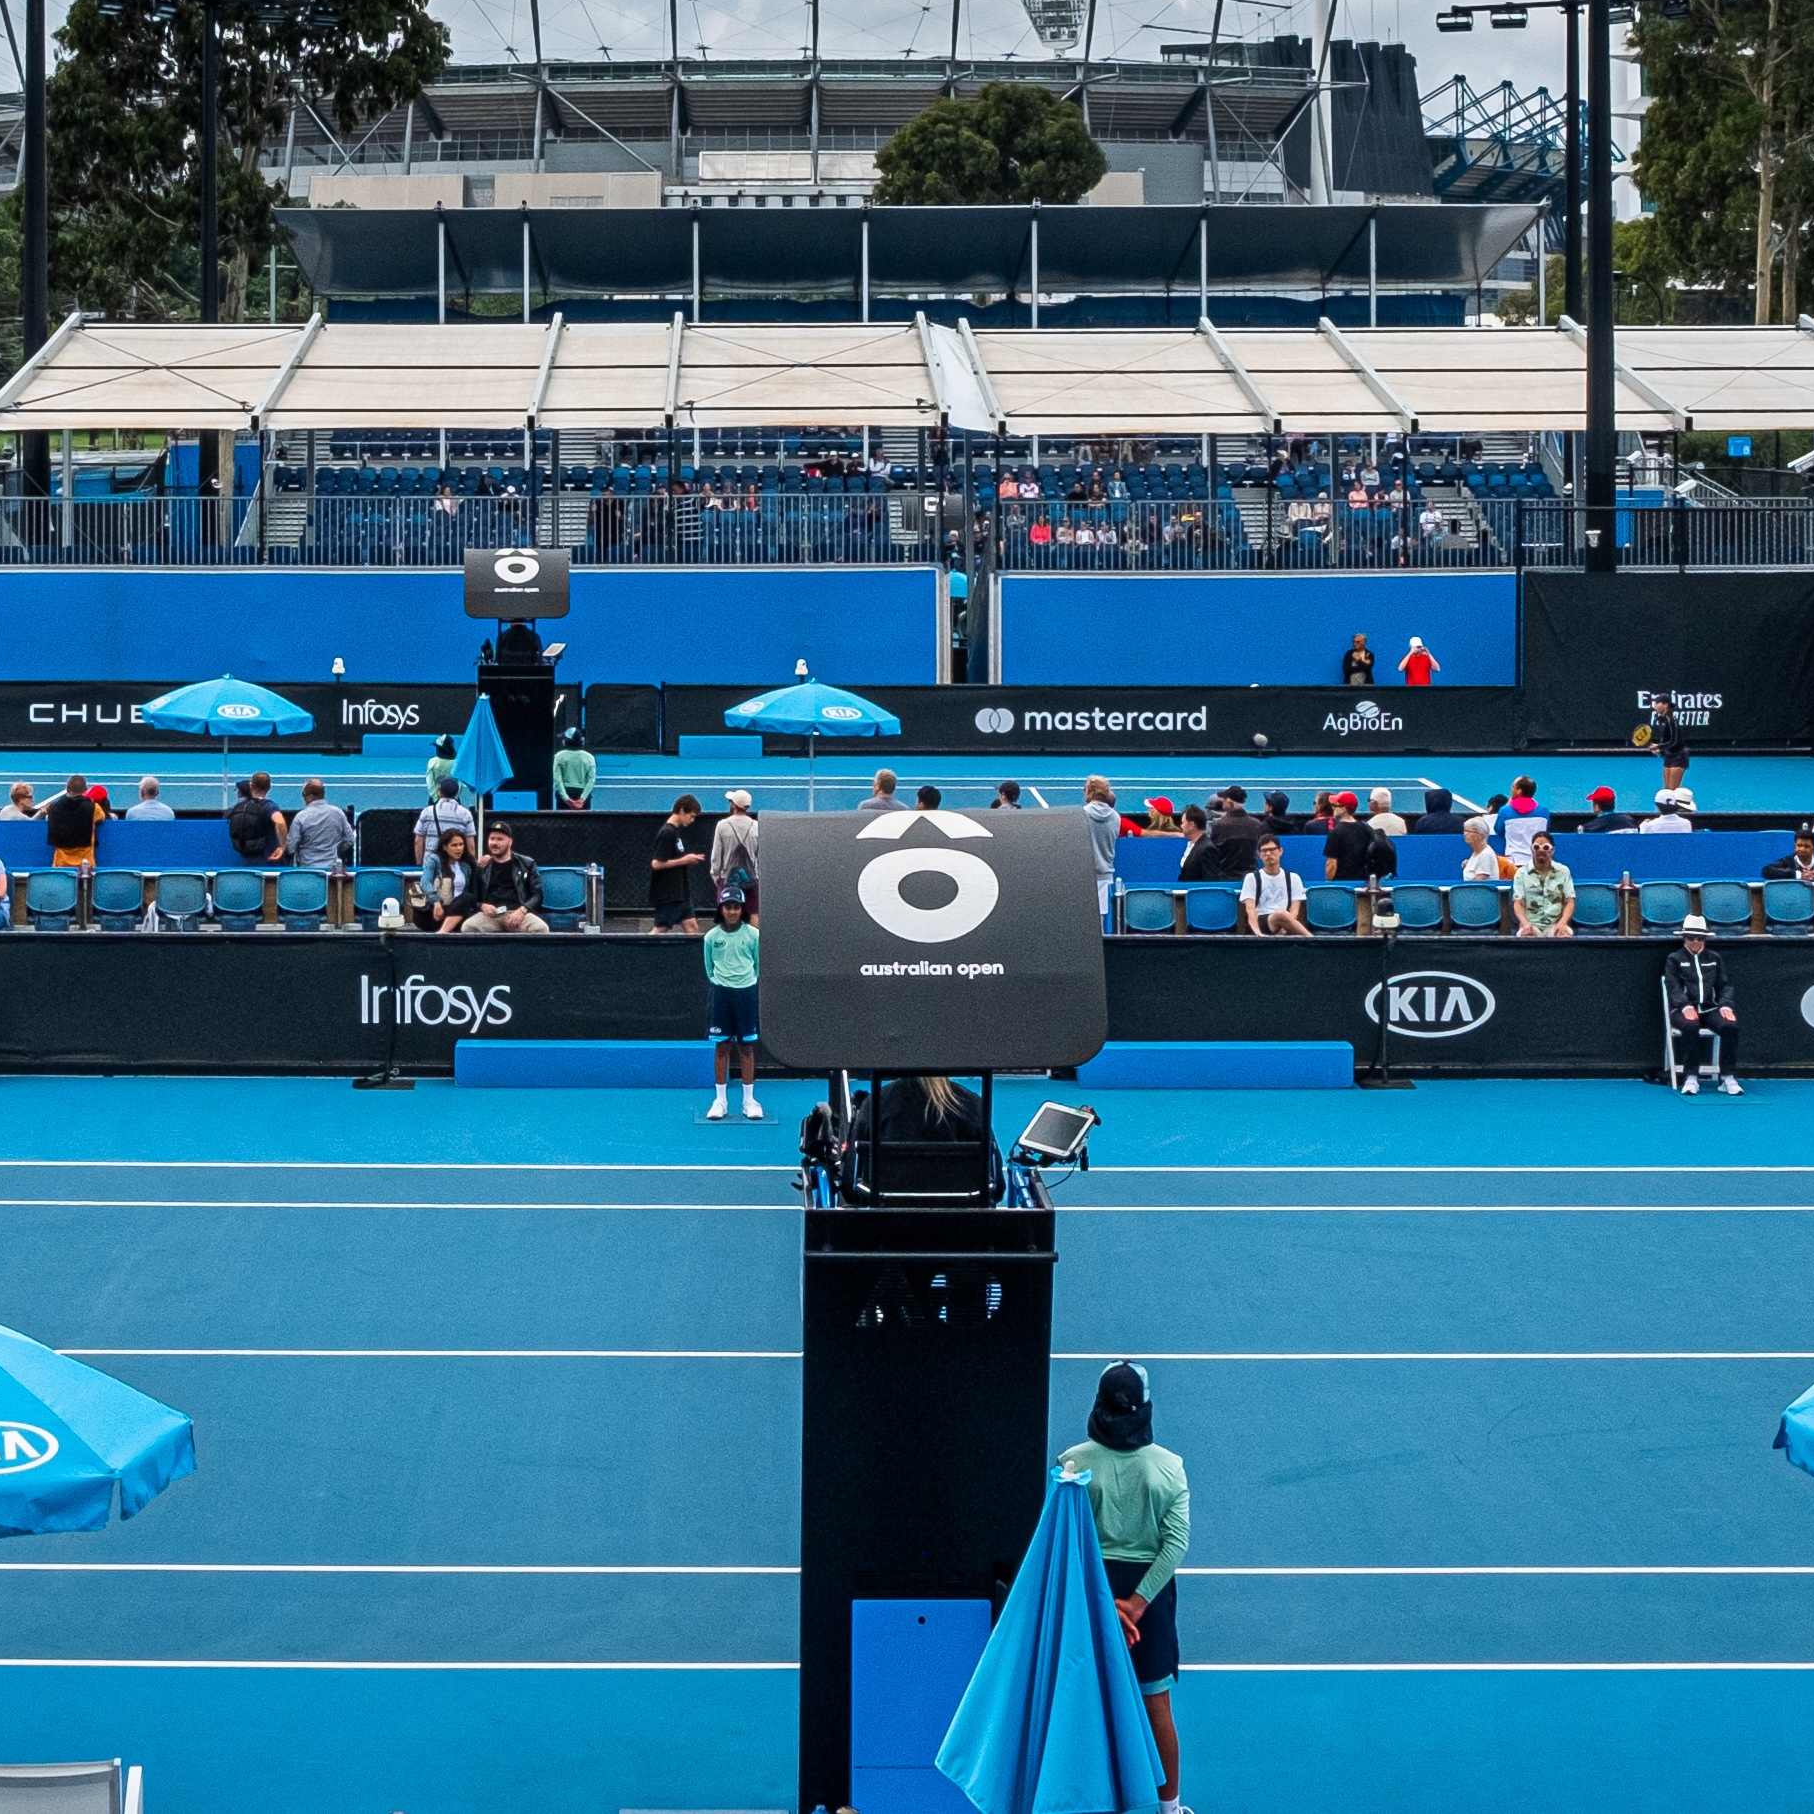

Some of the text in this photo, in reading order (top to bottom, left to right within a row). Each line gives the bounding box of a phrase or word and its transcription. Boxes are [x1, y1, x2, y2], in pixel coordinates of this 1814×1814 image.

[1637, 690, 1723, 709] Eirates
[342, 698, 420, 730] Infosys
[1024, 706, 1208, 732] mastercard
[1322, 712, 1403, 736] AgBioEn
[860, 960, 1005, 979] australian open
[360, 974, 513, 1034] Infosys
[1387, 986, 1474, 1023] KIA
